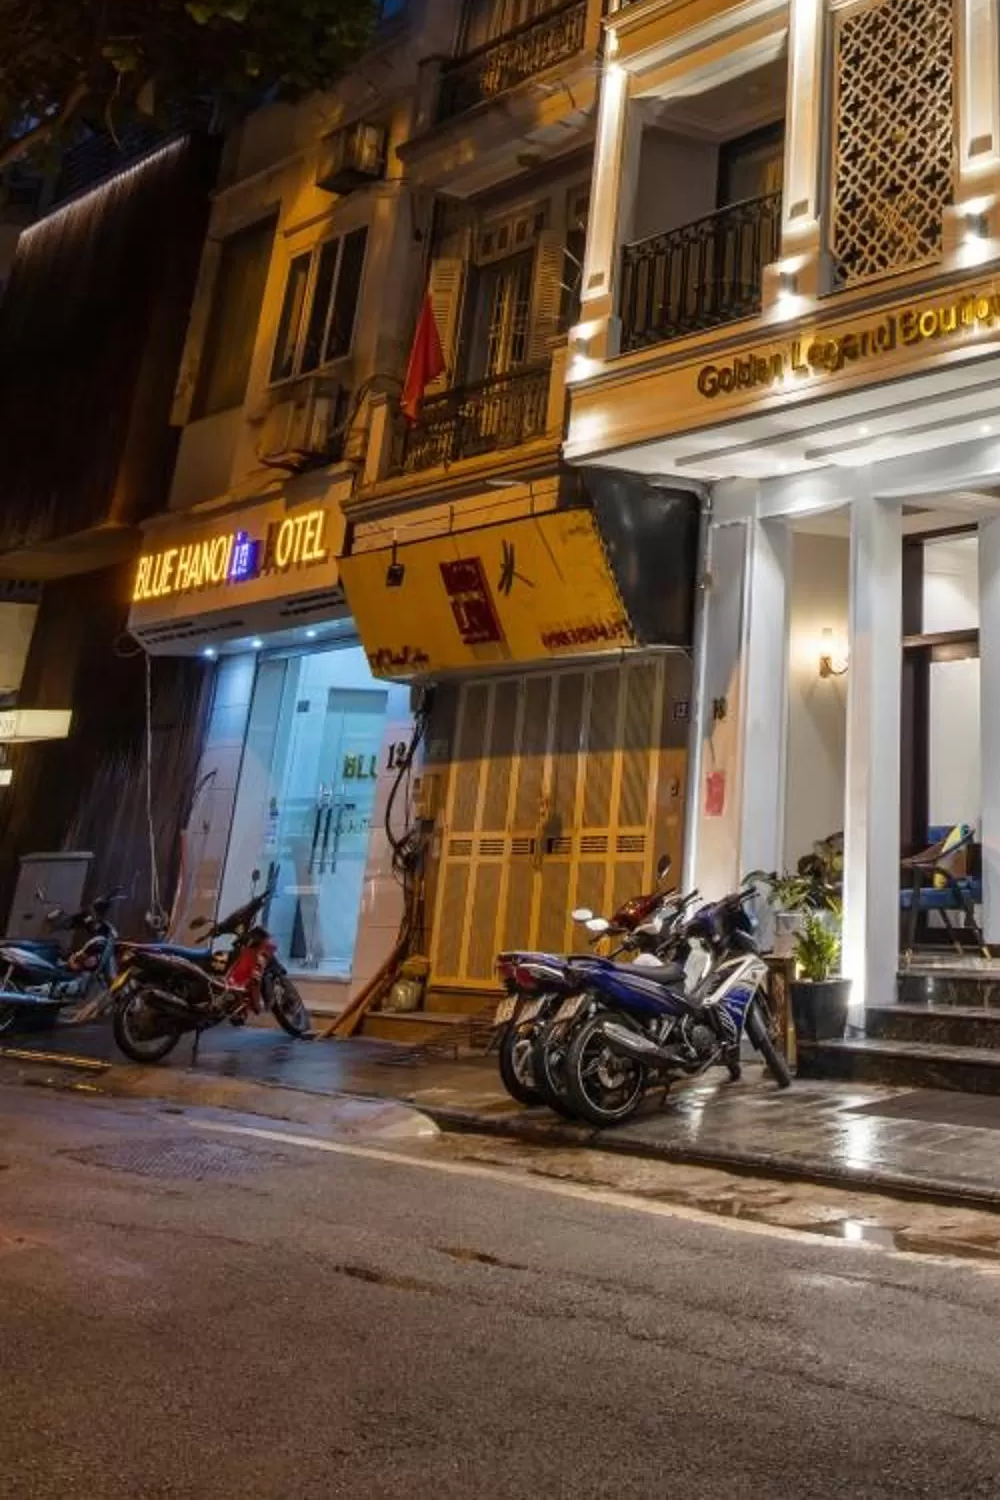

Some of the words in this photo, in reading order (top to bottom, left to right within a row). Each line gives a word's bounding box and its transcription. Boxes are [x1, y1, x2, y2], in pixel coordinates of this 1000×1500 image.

[697, 352, 784, 398] Golden
[791, 314, 897, 373] Legend
[132, 548, 179, 601] BLUE
[173, 533, 235, 591] HANOI
